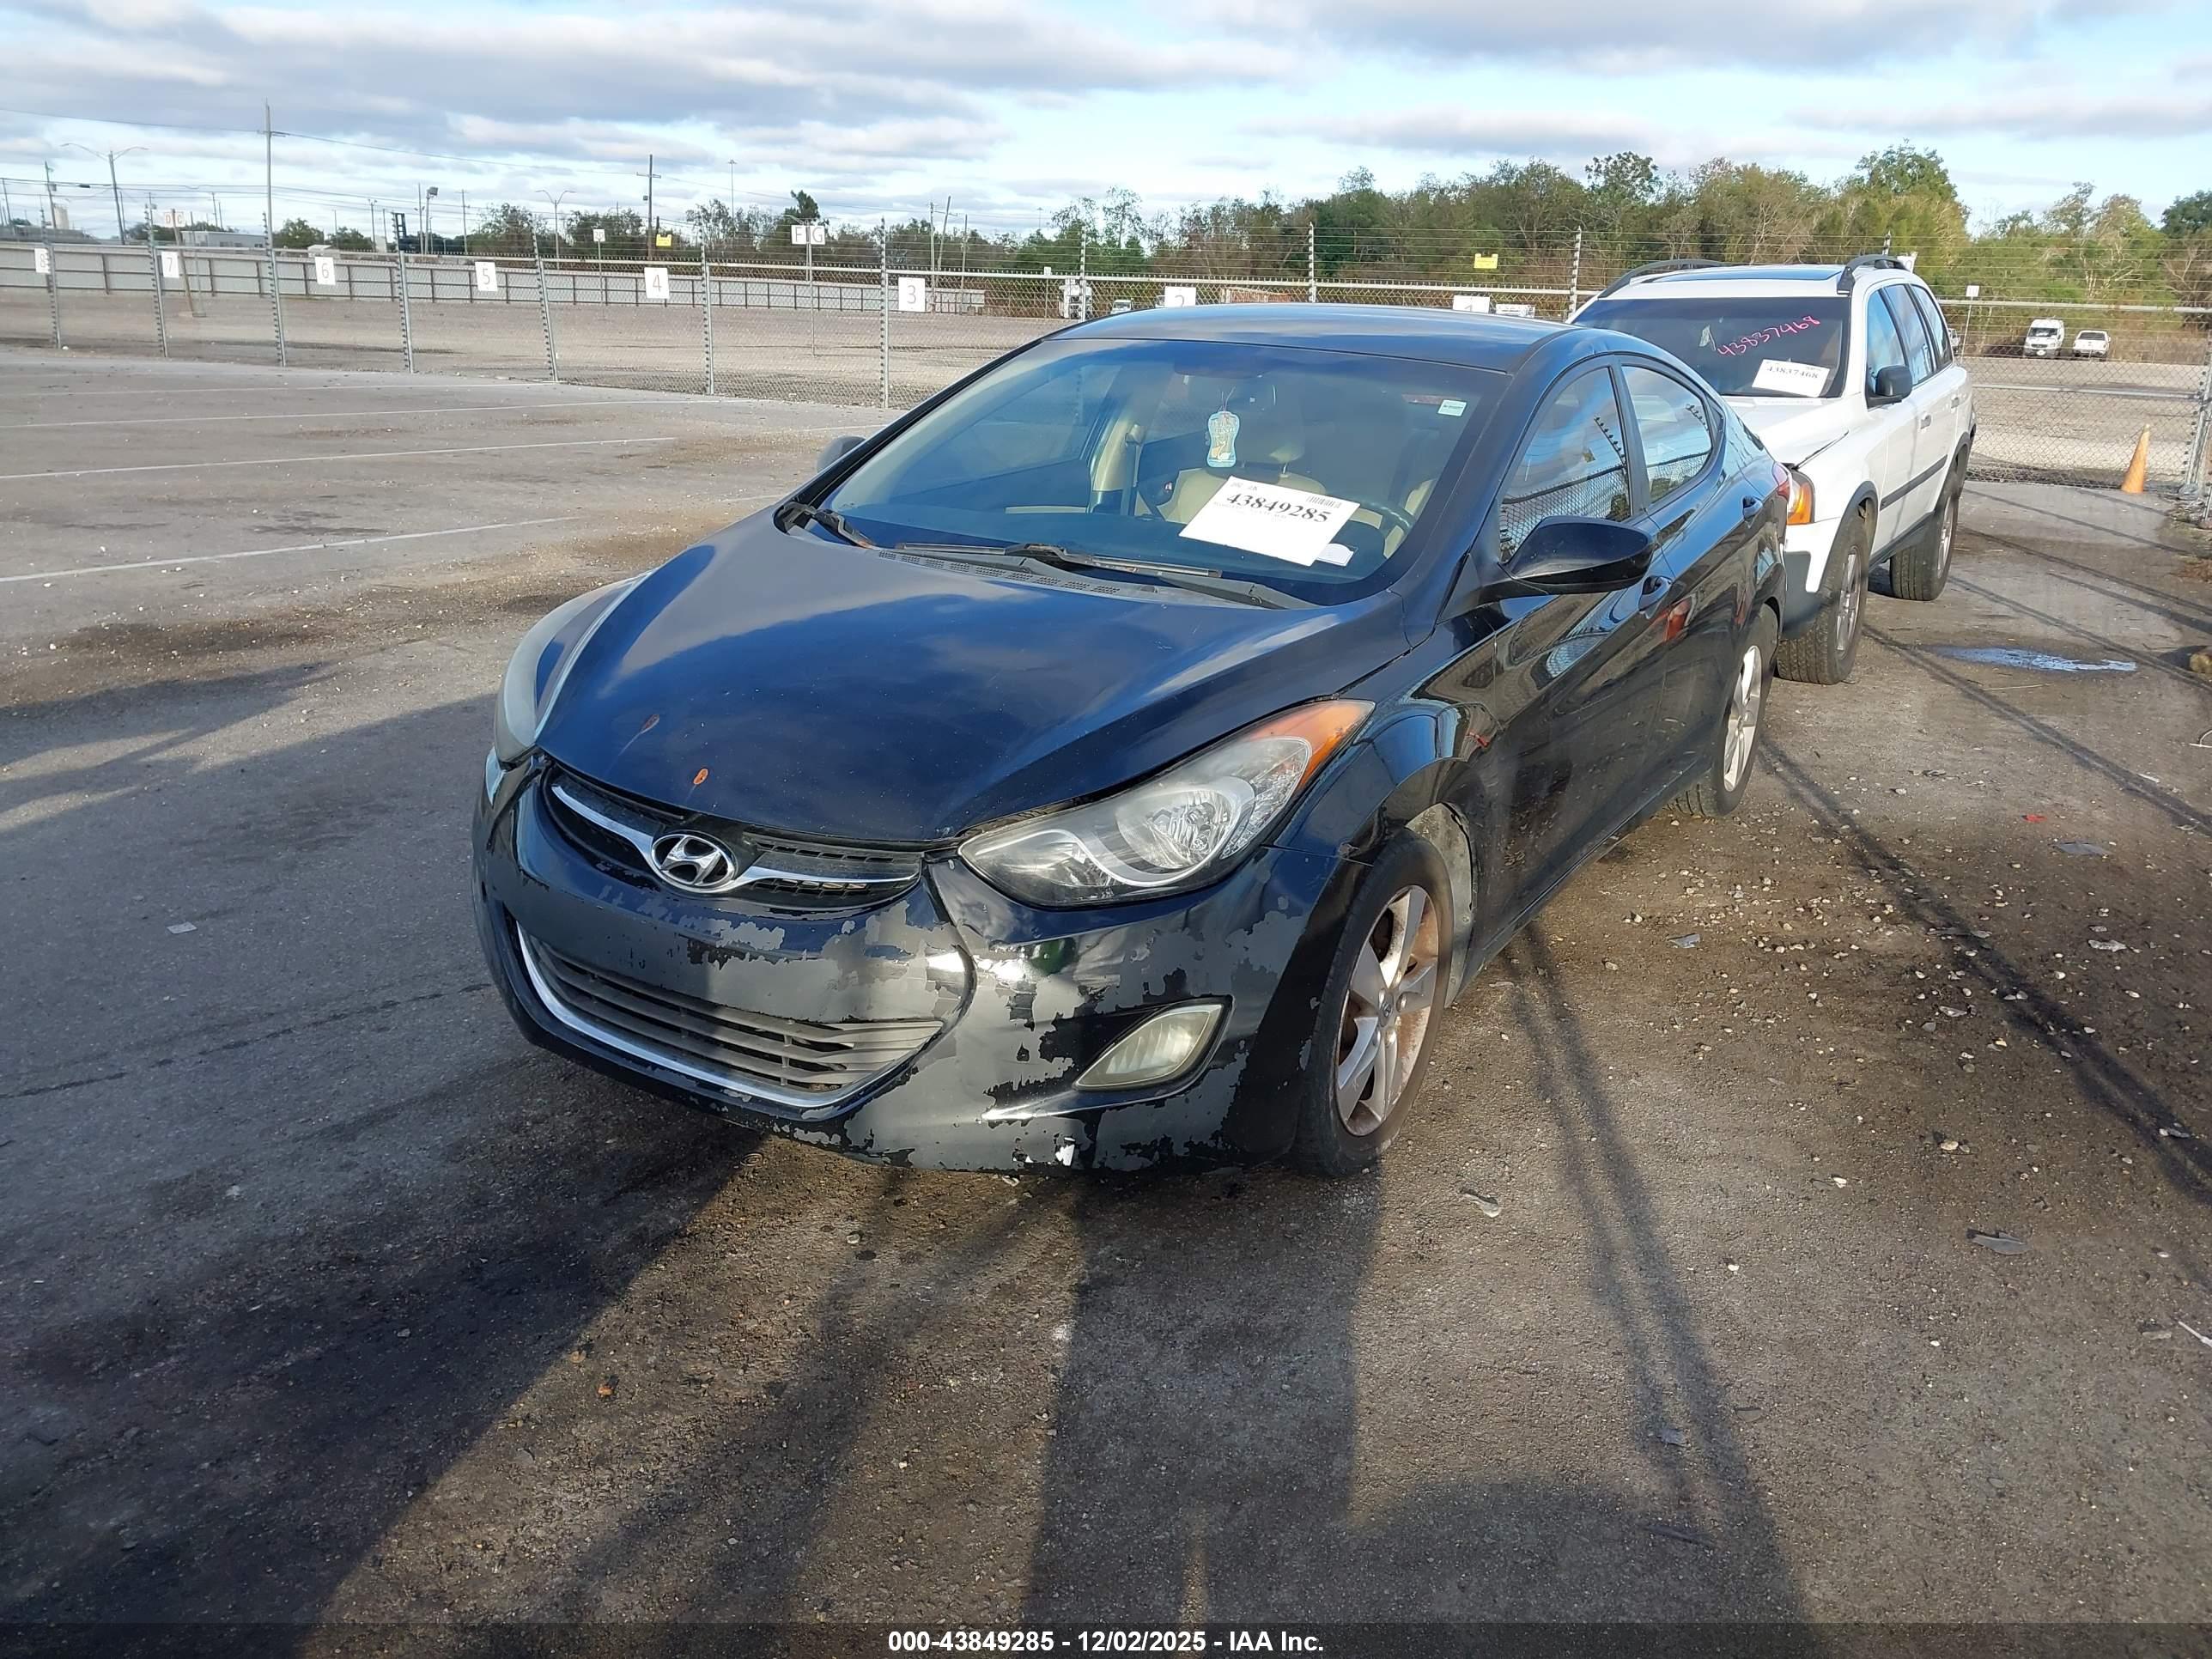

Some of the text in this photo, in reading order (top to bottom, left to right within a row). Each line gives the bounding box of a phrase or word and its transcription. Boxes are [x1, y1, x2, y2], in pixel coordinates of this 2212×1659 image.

[795, 226, 823, 244] F G
[167, 257, 173, 273] 7
[321, 262, 330, 279] 6
[482, 268, 491, 285] 5
[652, 274, 662, 293] 4
[906, 284, 917, 305] 3
[1717, 315, 1821, 356] 43837468
[1226, 492, 1332, 523] 43849285
